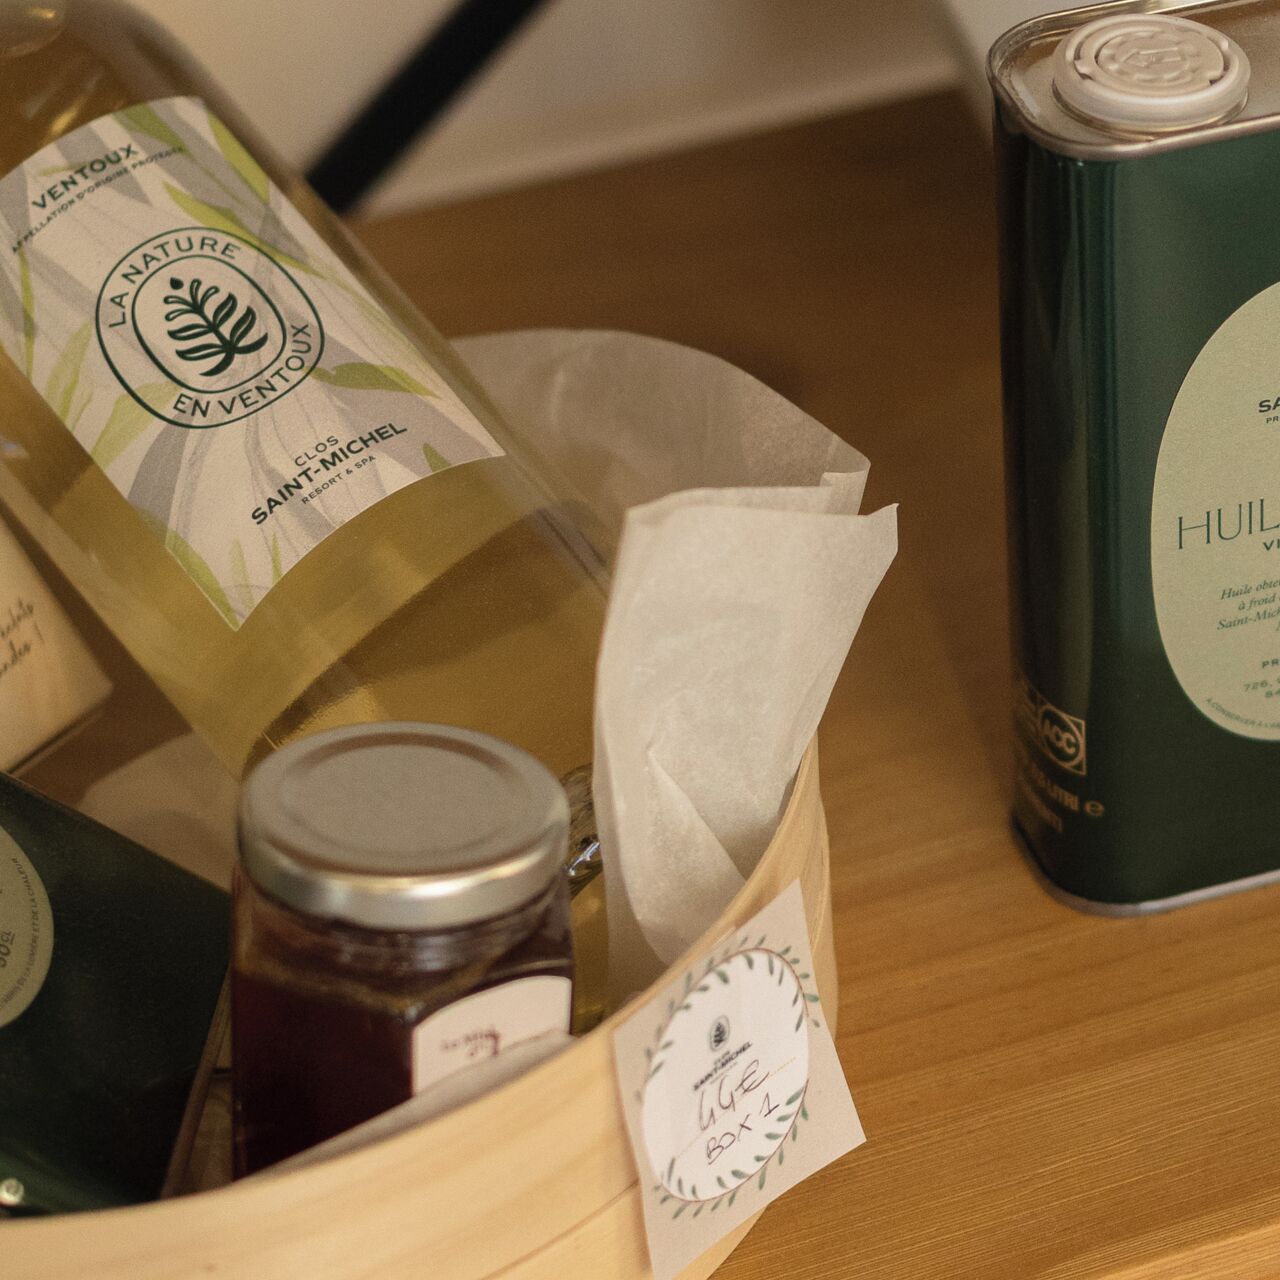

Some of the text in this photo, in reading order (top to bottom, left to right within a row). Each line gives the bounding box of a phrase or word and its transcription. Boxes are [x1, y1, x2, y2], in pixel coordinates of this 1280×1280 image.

[32, 143, 139, 209] VENTOUX
[109, 236, 241, 328] LA NATURE
[173, 323, 312, 418] EN VENTOUX
[251, 423, 408, 525] SAINT-MICHEL
[294, 435, 339, 467] CLOS
[301, 473, 344, 505] RESORT
[354, 455, 376, 469] SPA
[1220, 583, 1253, 600] Huile
[1247, 593, 1276, 611] froid
[706, 1113, 753, 1165] BOX
